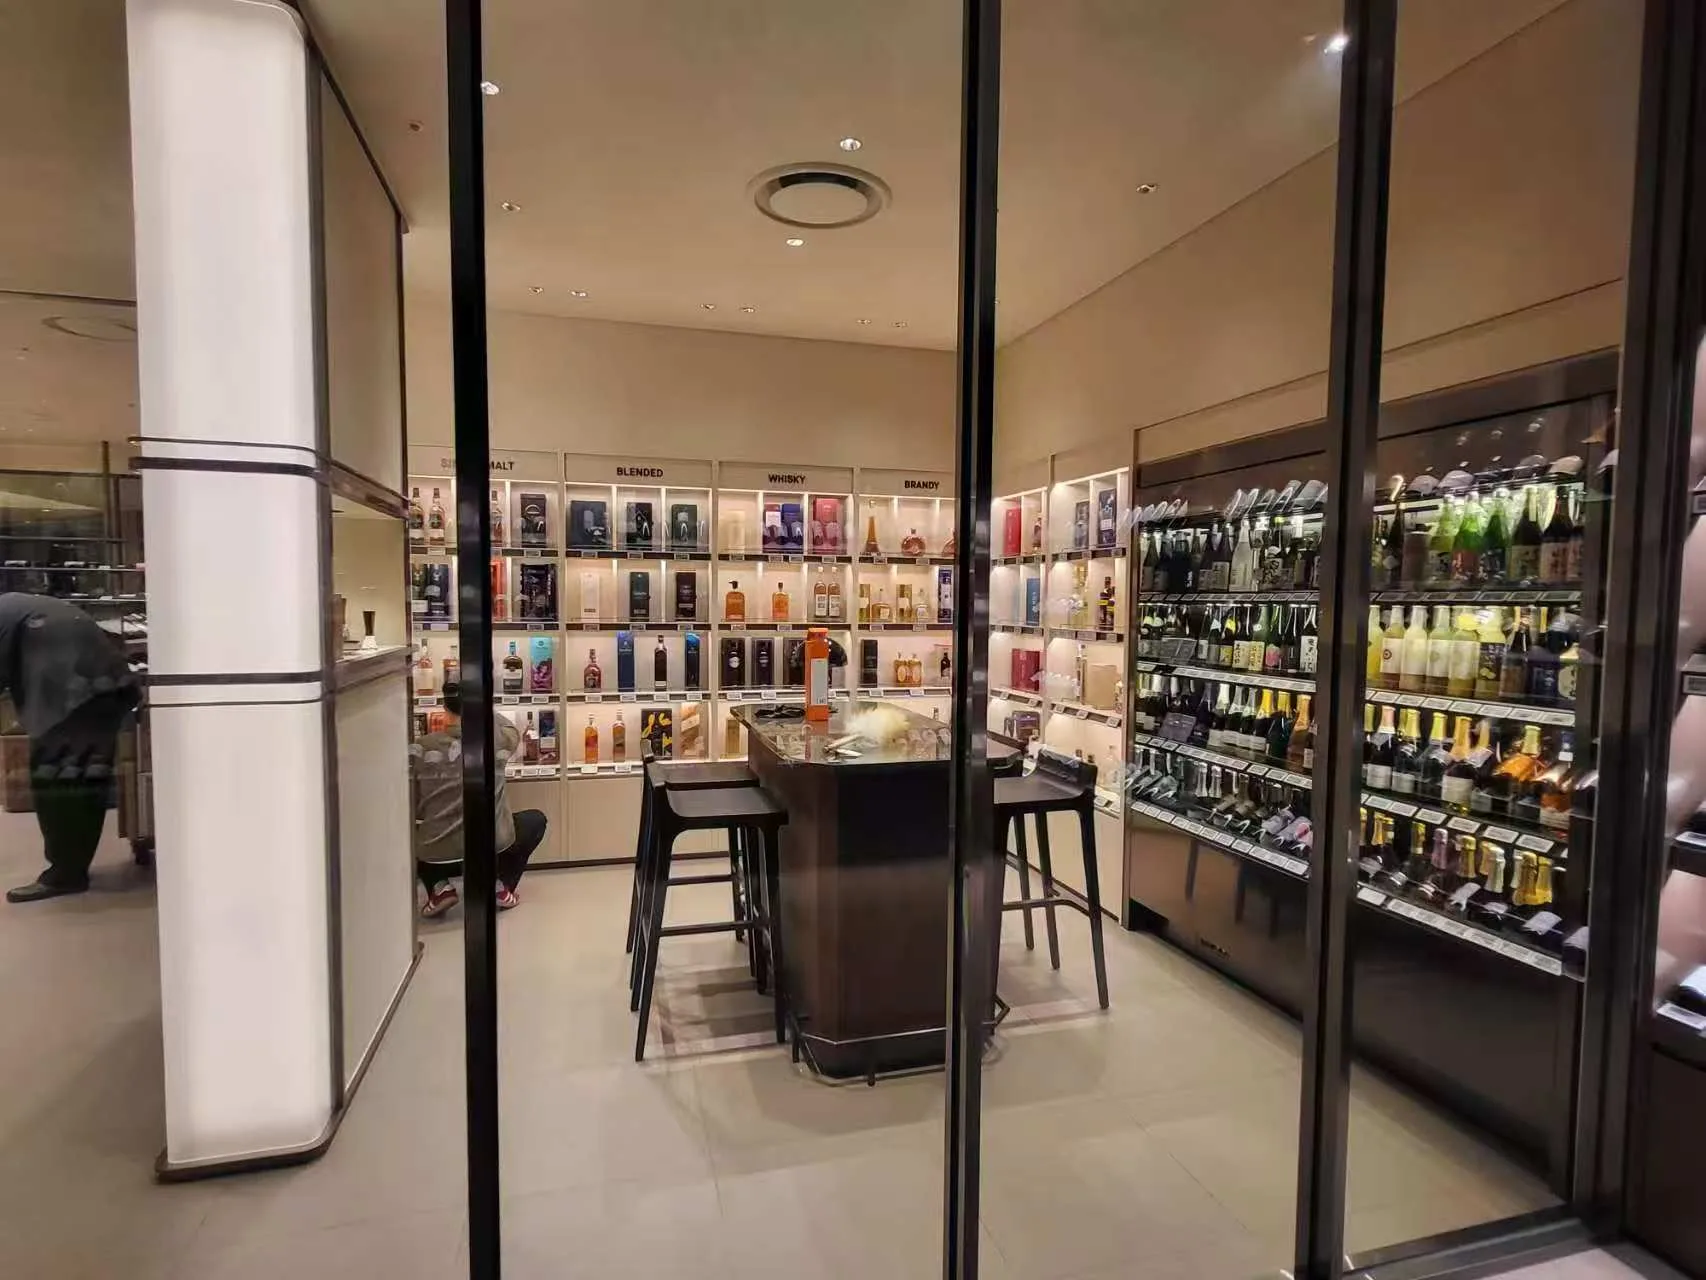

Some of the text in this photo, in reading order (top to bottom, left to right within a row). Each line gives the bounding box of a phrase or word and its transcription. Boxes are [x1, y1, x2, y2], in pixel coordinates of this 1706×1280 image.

[616, 466, 664, 478] BLENDED
[768, 474, 806, 484] WHISKY
[904, 480, 940, 491] BRANDY
